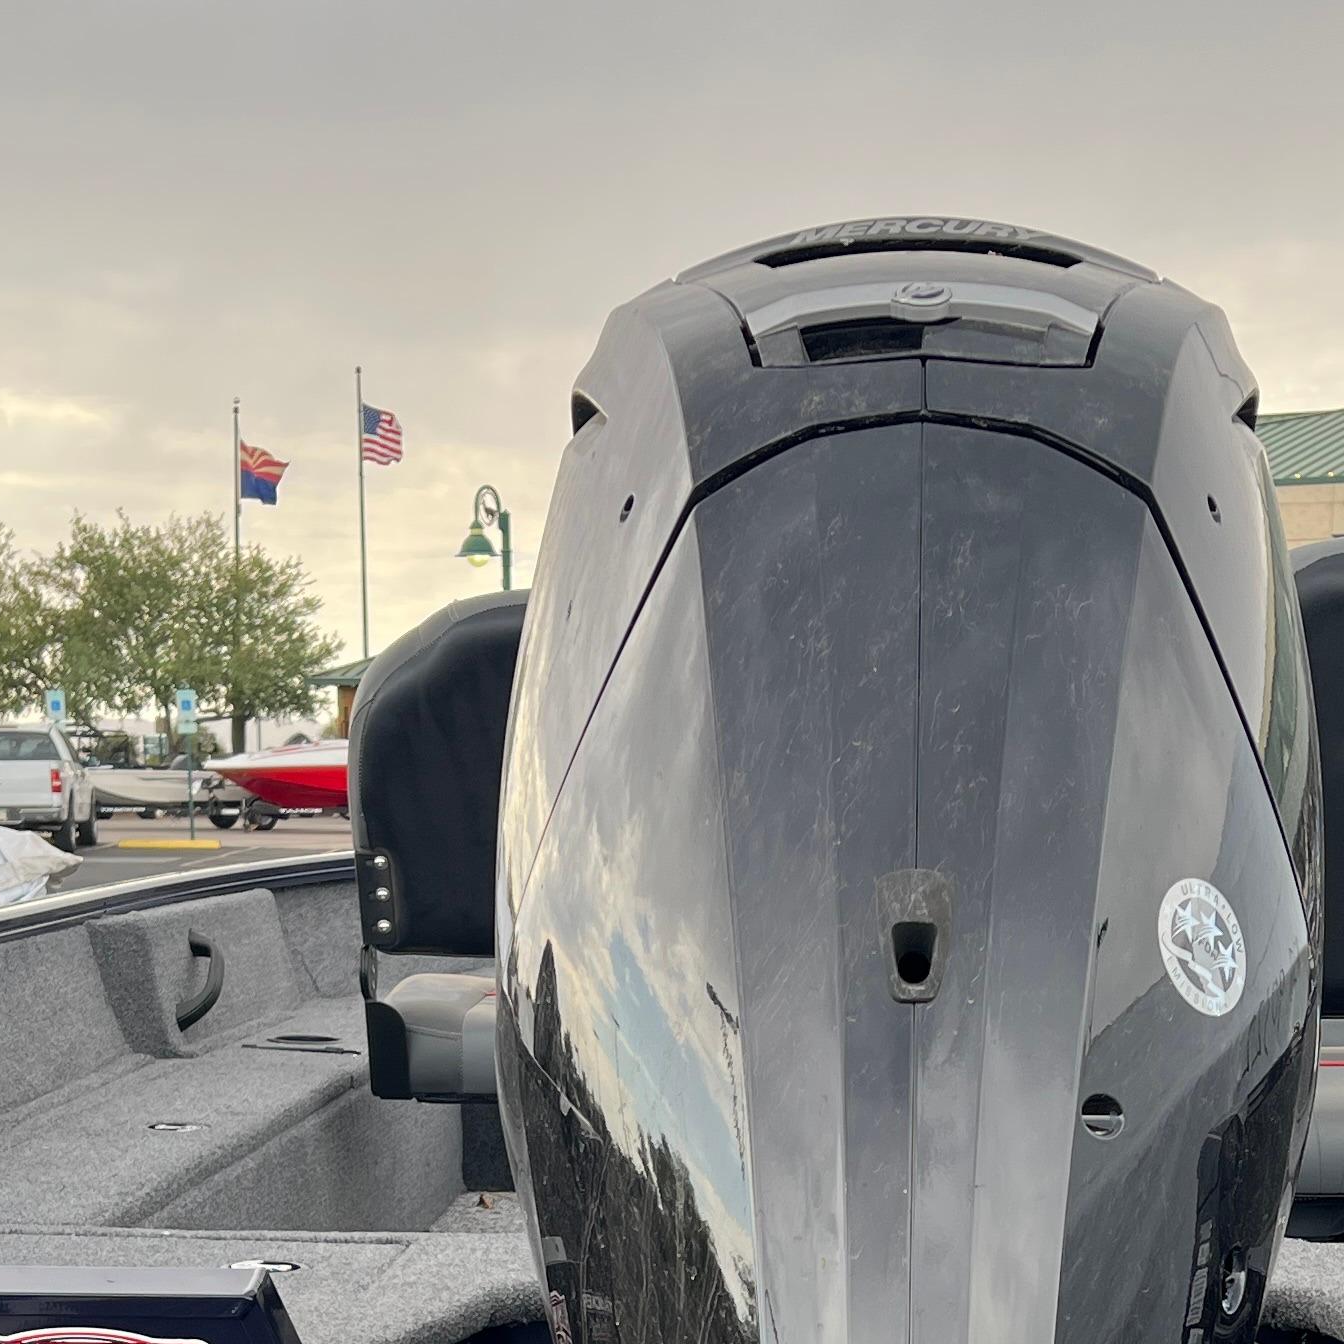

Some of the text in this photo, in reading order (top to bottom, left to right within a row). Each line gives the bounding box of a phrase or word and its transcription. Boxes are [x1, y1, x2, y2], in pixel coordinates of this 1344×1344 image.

[790, 219, 1040, 245] MERCURY
[1181, 884, 1219, 905] ULTRA
[1225, 912, 1244, 953] LOW
